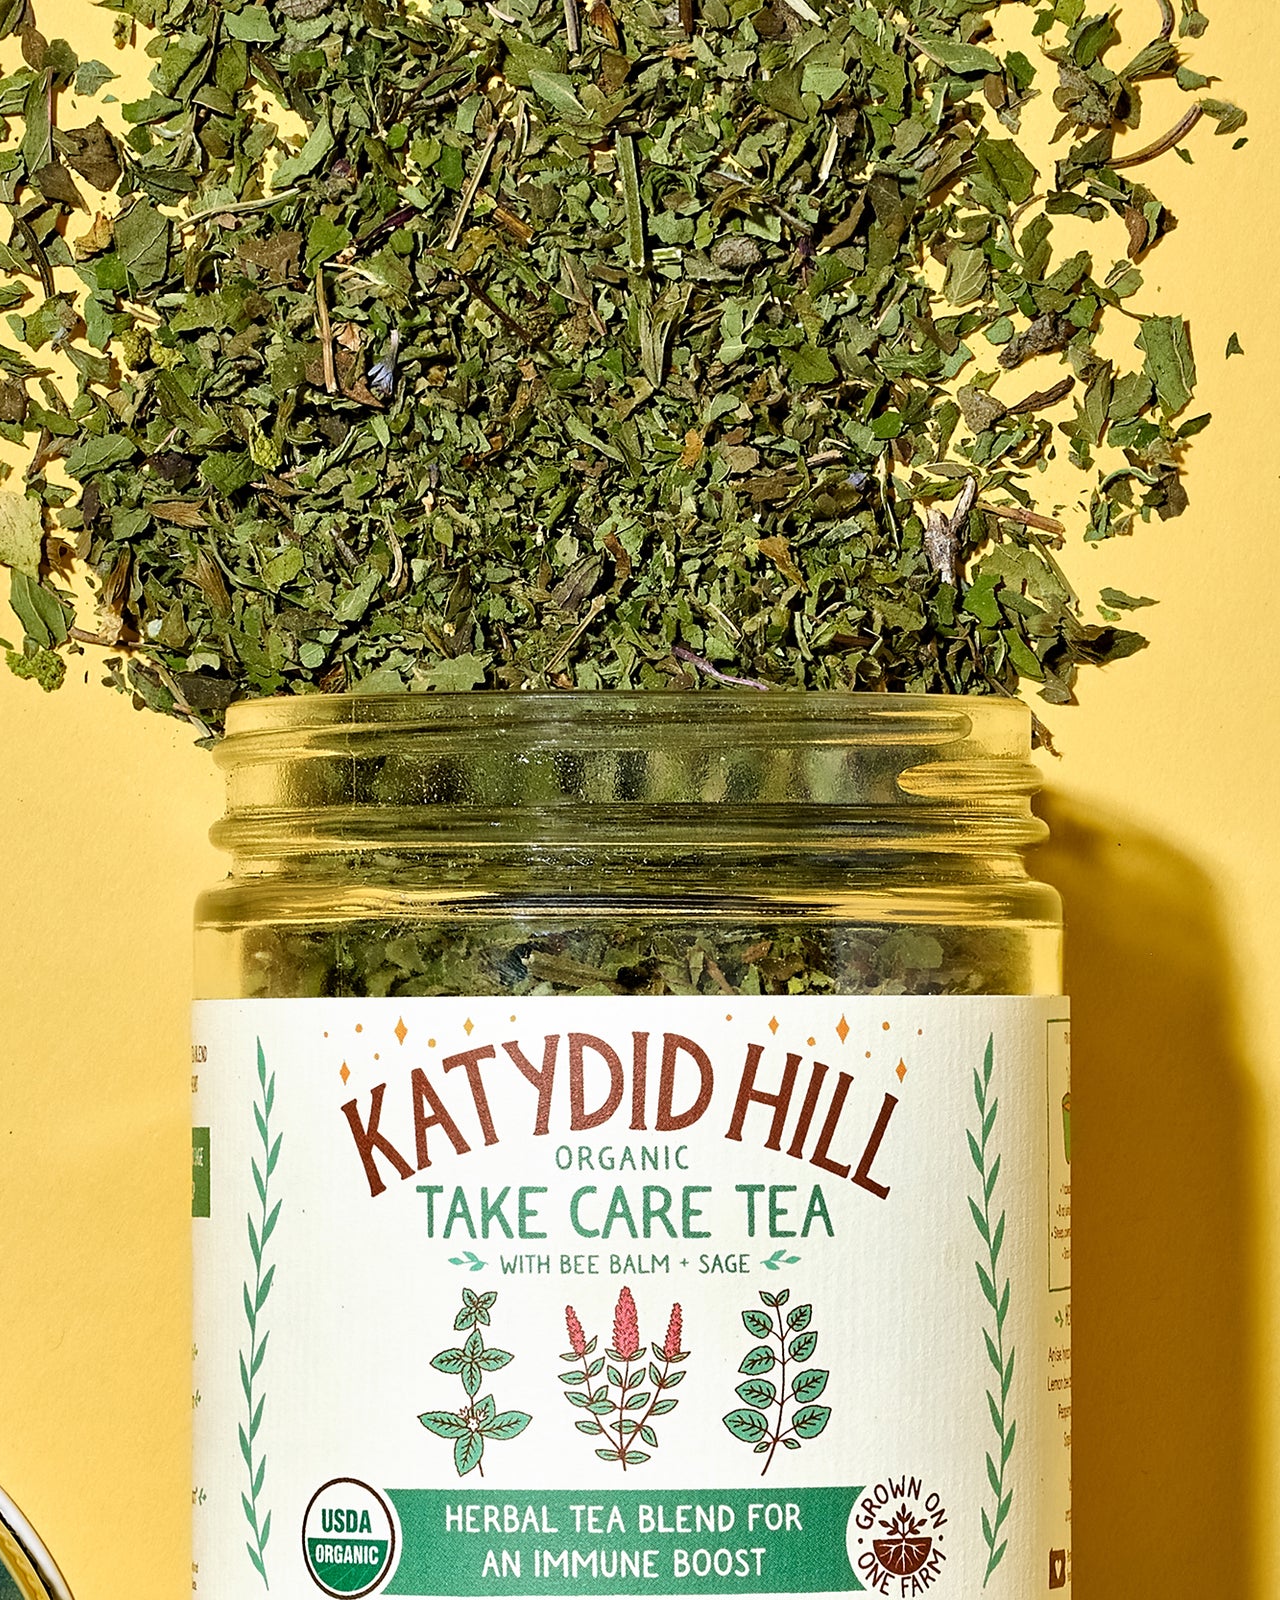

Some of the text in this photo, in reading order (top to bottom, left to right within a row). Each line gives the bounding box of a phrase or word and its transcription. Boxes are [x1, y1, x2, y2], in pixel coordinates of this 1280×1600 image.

[340, 1031, 899, 1201] KATYDID HILL
[555, 1144, 689, 1171] ORGANIC
[416, 1184, 836, 1239] TAKE CARE TEA
[499, 1253, 550, 1275] WITH
[559, 1254, 599, 1275] BEE
[609, 1253, 670, 1275] BALM
[698, 1253, 751, 1275] SAGE
[855, 1474, 948, 1530] GROWN ON
[321, 1508, 372, 1534] USDA
[445, 1503, 803, 1534] HERBAL TEA BLEND FOR
[315, 1543, 380, 1565] ORGANIC
[481, 1548, 767, 1578] AN IMMUNE BOOST
[858, 1548, 947, 1598] ONE FARM
